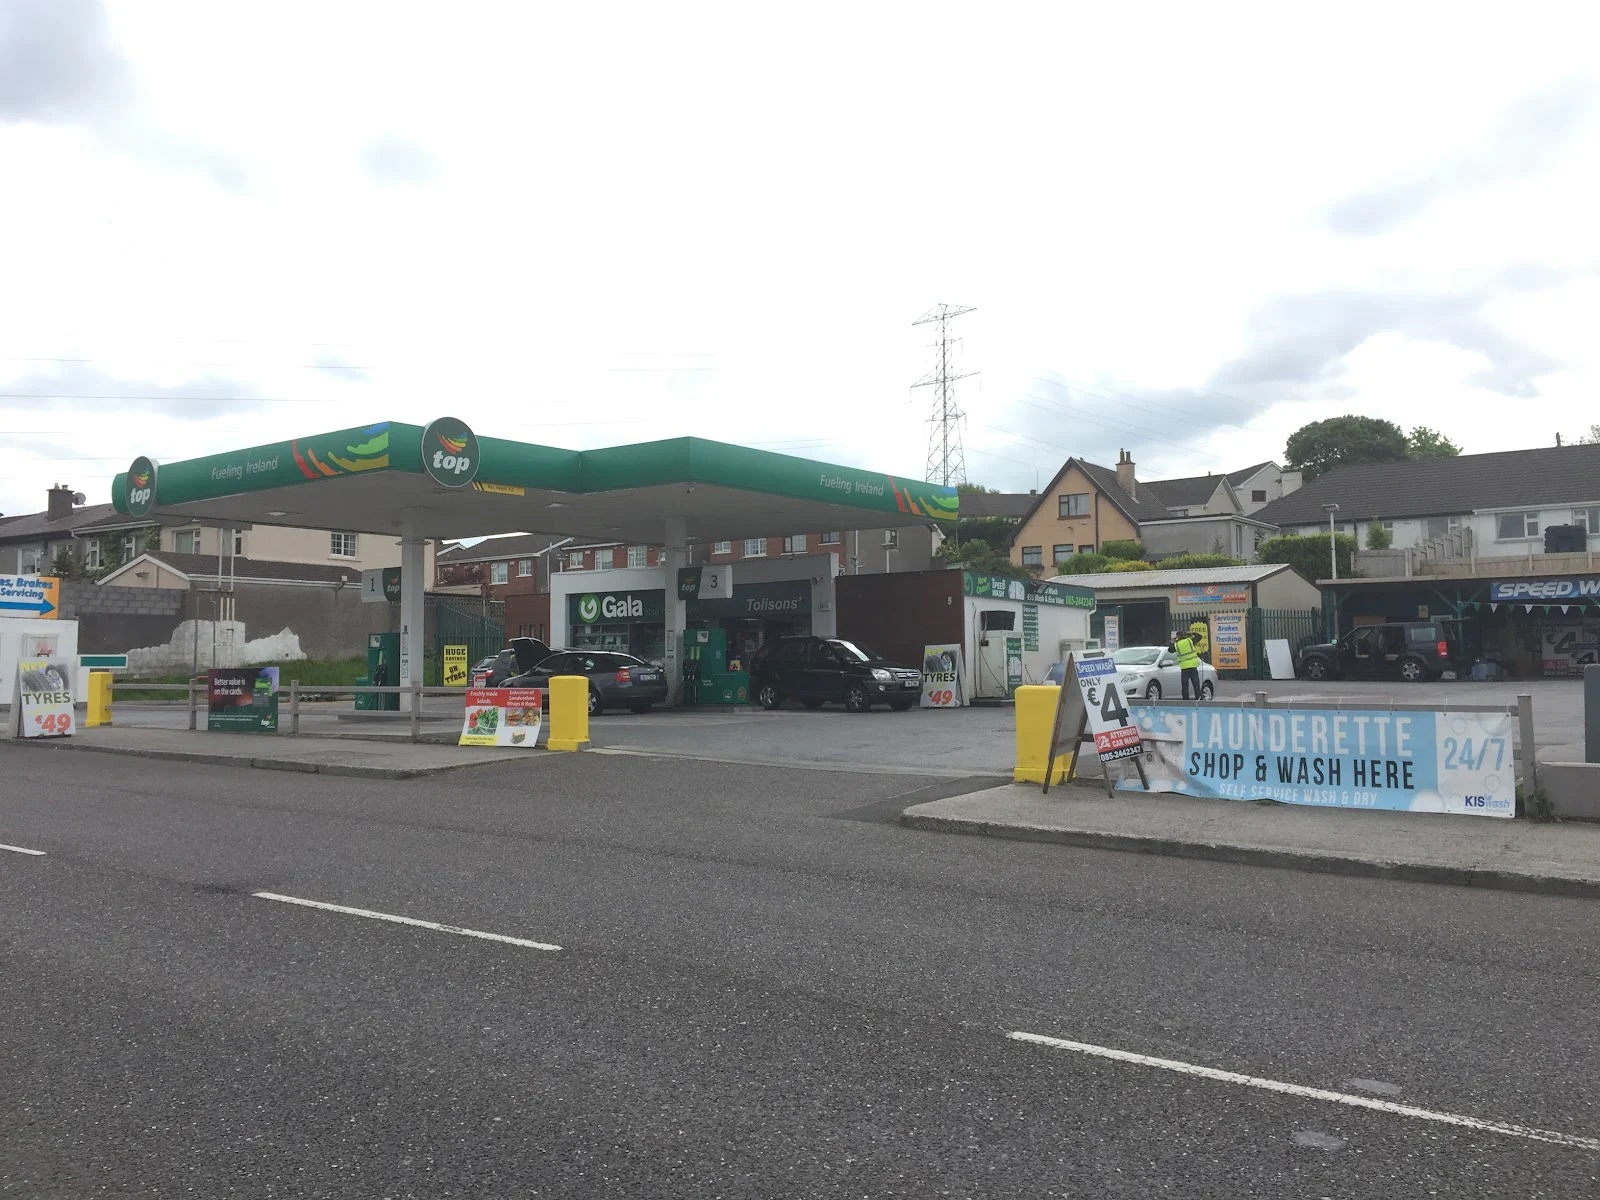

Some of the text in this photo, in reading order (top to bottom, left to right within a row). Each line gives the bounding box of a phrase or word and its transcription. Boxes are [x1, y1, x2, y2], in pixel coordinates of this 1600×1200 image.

[211, 456, 279, 480] Fueling Ireland
[432, 450, 470, 475] top
[820, 474, 884, 497] Fueling Ireland
[130, 487, 151, 505] top
[16, 577, 53, 589] Brakes
[370, 577, 376, 592] 1
[387, 583, 400, 593] top
[681, 583, 695, 592] top
[710, 574, 718, 589] 3
[992, 581, 1006, 590] SPEED
[0, 588, 44, 600] Servicing
[992, 589, 1005, 598] WASH
[1206, 586, 1214, 595] &
[1498, 580, 1600, 598] SPEED W
[602, 595, 643, 619] Gala
[445, 648, 466, 656] HUGE
[449, 665, 459, 673] ON
[1076, 660, 1114, 674] SPEED WASH
[214, 678, 246, 686] Better value is
[445, 671, 467, 683] TYRES
[923, 672, 956, 683] TYRES
[1080, 677, 1101, 688] ONLY
[22, 691, 71, 705] TYRES
[221, 688, 229, 696] the
[470, 690, 485, 698] Freshly
[928, 689, 953, 705] €49
[35, 713, 71, 734] €49
[1110, 728, 1137, 739] ATTENDED
[1191, 712, 1413, 757] LAUNDERETTE
[1112, 736, 1140, 748] CAR WASH
[1100, 745, 1141, 762] 085-2442347
[1444, 737, 1506, 771] 24/7
[1189, 752, 1415, 790] SHOP & WASH HERE
[1219, 783, 1378, 806] SELF SERVICE WASH & DRY
